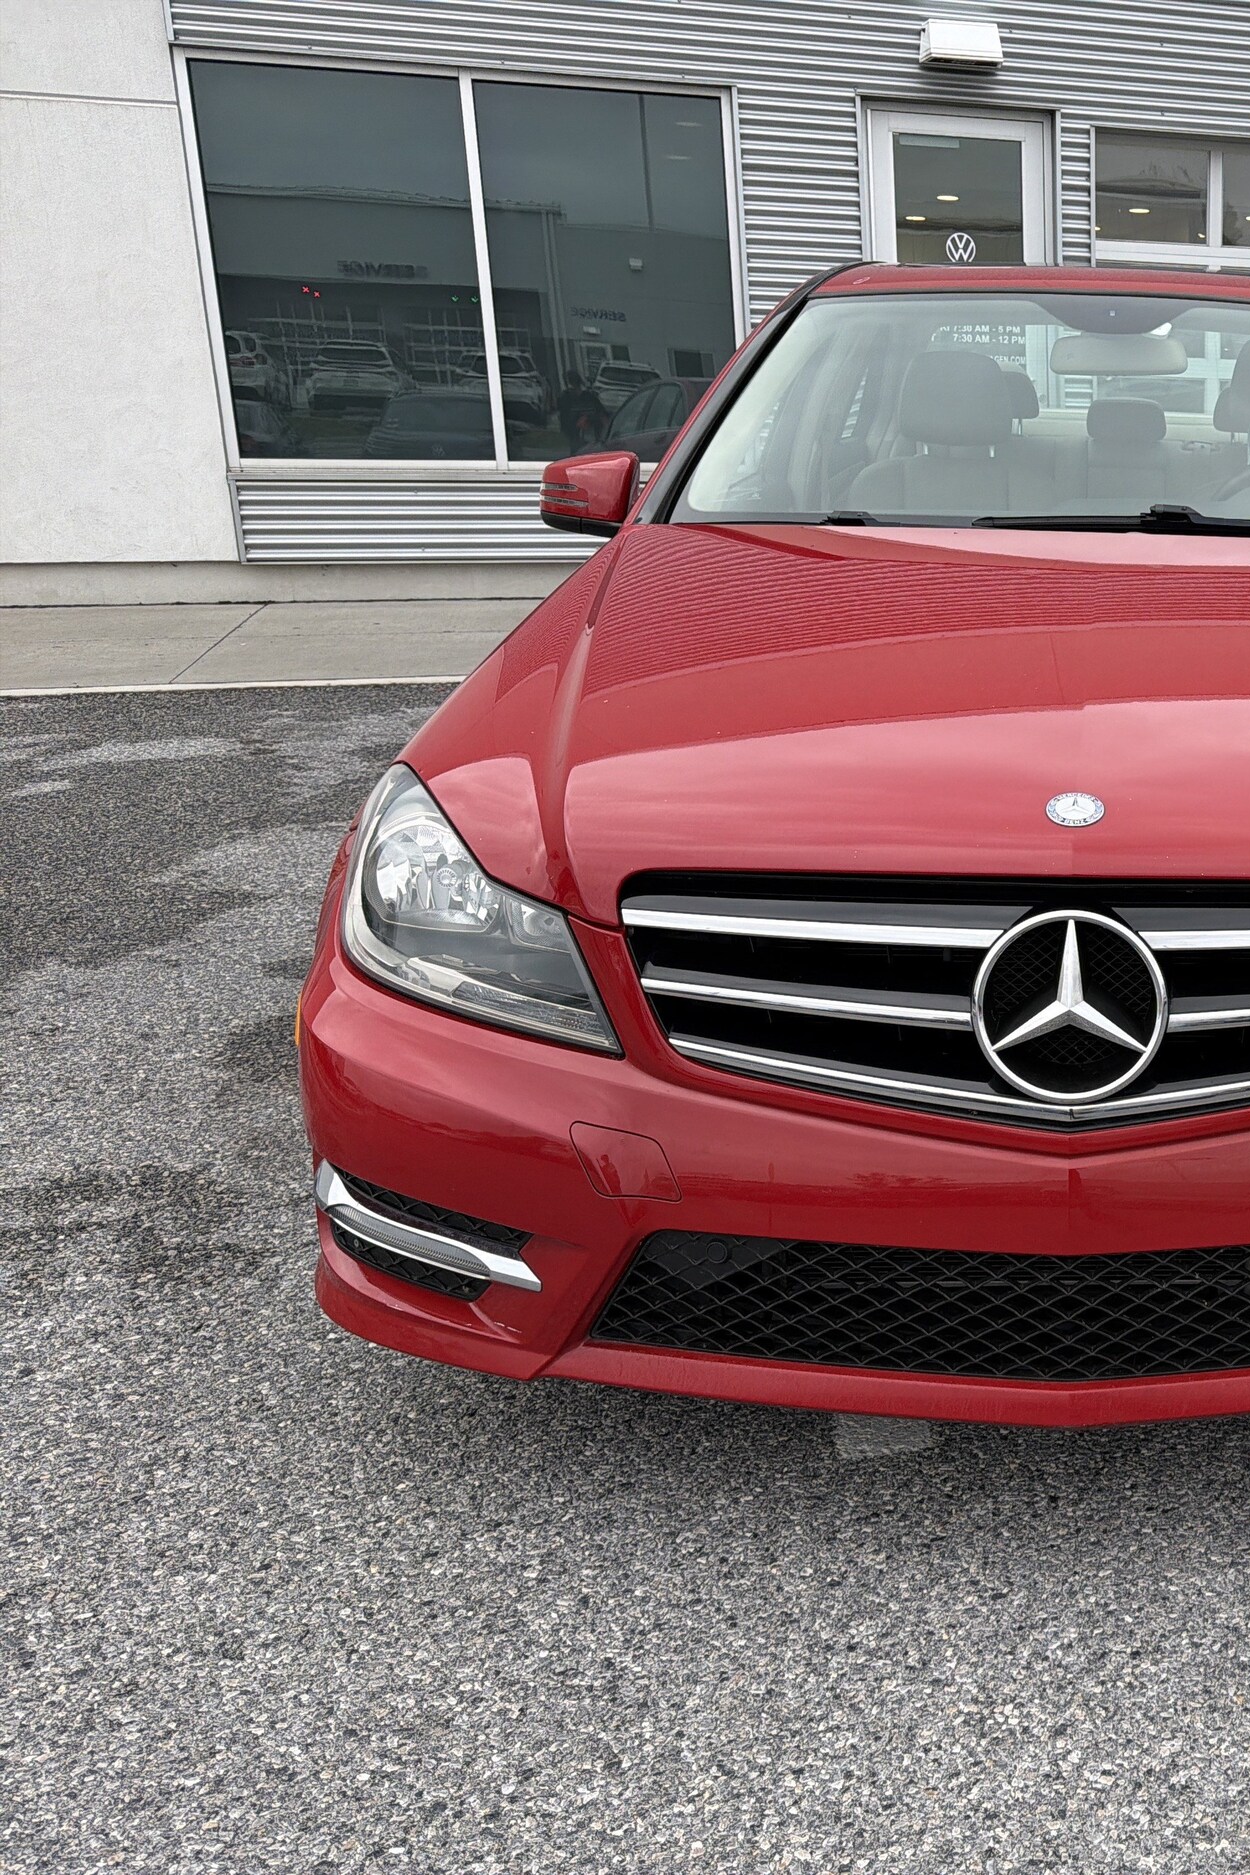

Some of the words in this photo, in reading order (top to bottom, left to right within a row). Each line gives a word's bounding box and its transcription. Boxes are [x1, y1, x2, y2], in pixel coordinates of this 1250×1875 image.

[946, 232, 976, 262] VW
[998, 325, 1004, 333] 5
[953, 333, 973, 343] 7:30
[974, 334, 990, 343] AM
[998, 335, 1009, 344] 12
[1011, 336, 1026, 344] PM
